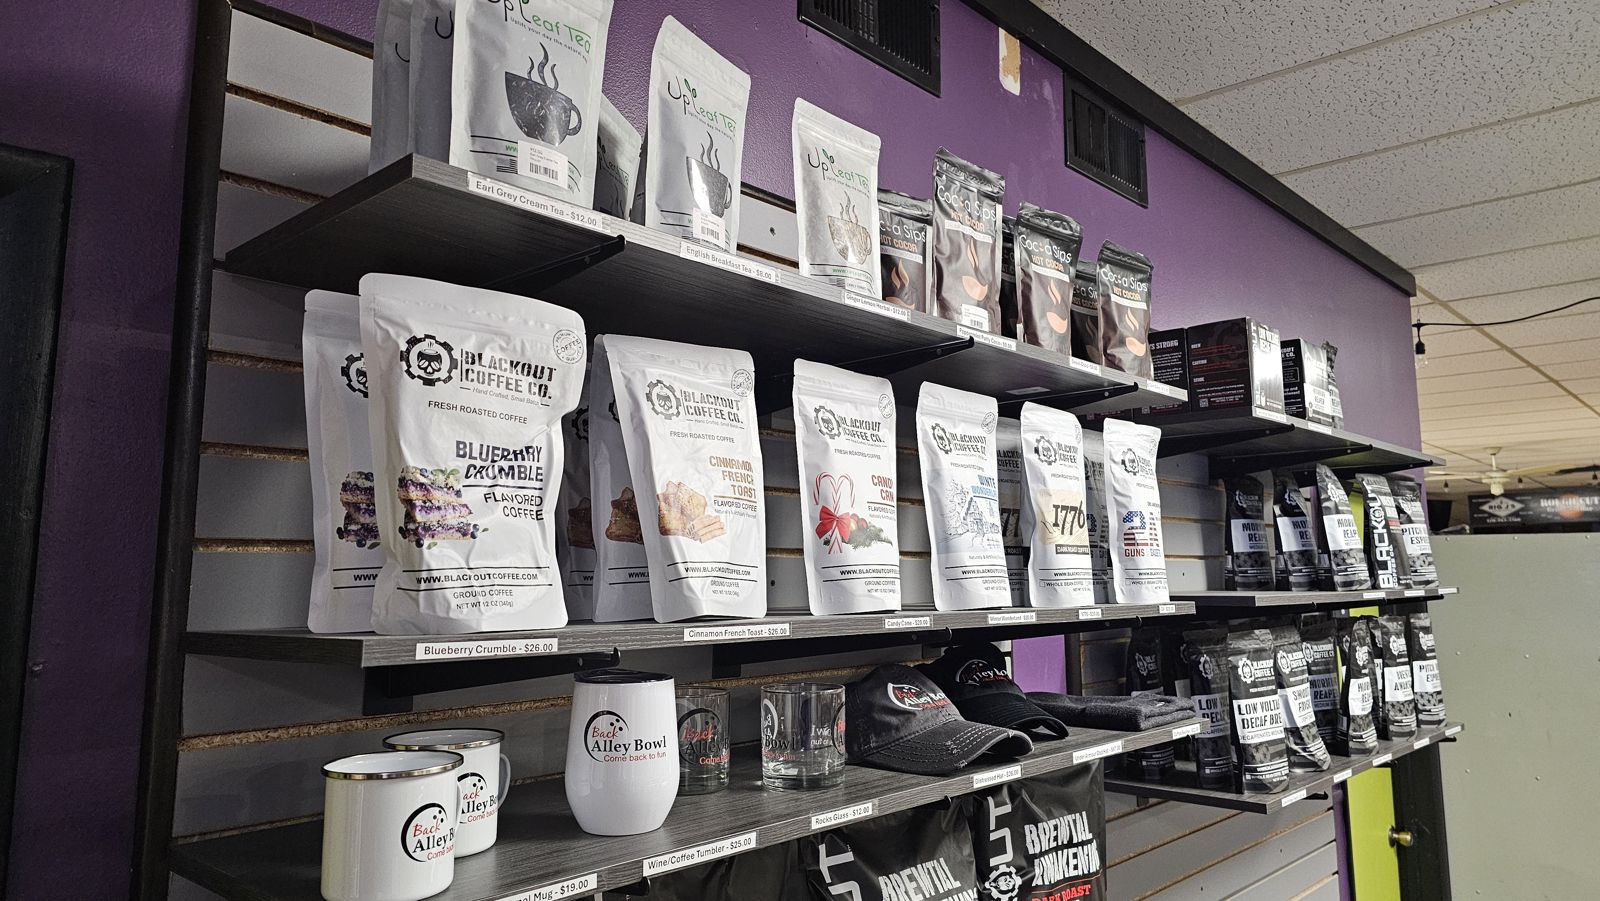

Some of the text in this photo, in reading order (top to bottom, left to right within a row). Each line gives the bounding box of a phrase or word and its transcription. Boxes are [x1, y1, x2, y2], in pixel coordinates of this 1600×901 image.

[564, 24, 591, 54] Tea
[476, 180, 597, 226] Earl Grey Cream Tea $12.00
[974, 200, 996, 221] Sips
[904, 224, 926, 242] Sips
[965, 218, 985, 232] COCOA
[893, 240, 918, 252] COCOA
[686, 246, 772, 280] English Breakfast Tea $8.00
[1031, 255, 1064, 272] HOT COCOA
[1053, 246, 1072, 264] Sips
[1130, 276, 1148, 292] Sips
[1122, 290, 1141, 301] COCOA
[1156, 340, 1179, 350] STRONG
[465, 350, 556, 382] BLACKOUT
[465, 368, 552, 400] COFFEE CO.
[683, 390, 740, 411] BLACKOUT
[428, 400, 528, 424] FRESH ROASTED COFFEE
[686, 405, 743, 424] COFFEE CO.
[838, 415, 881, 432] BLACKOUT
[842, 427, 885, 443] COFFEE CO.
[464, 464, 544, 482] CRUMBLE
[484, 492, 543, 507] FLAVORED
[731, 484, 756, 499] TOAST
[880, 488, 895, 503] CAN
[714, 500, 740, 509] FLAVORED
[502, 506, 544, 521] COFFEE
[1052, 500, 1085, 535] 1776
[1000, 508, 1020, 537] 77
[1124, 549, 1145, 557] GUNS
[416, 572, 538, 584] WWW.BLACKOUTCOFFEE.COM
[453, 589, 513, 599] GROUND COFFEE
[689, 630, 723, 638] Cinnamon
[424, 642, 553, 656] Blueberry Crumble $26.00
[904, 692, 946, 707] Alley Bo
[1198, 698, 1218, 710] LOW
[1237, 703, 1257, 715] LOW
[1260, 699, 1280, 713] VOLT
[1241, 713, 1282, 729] DECAF BRE
[592, 725, 618, 739] Back
[591, 736, 666, 756] Alley Bowl
[630, 753, 647, 761] back
[463, 782, 481, 800] ack
[468, 814, 485, 823] Come
[816, 806, 870, 825] Rocks Glass $12.00
[413, 817, 441, 837] Back
[1024, 811, 1093, 855] BREWTAL
[412, 832, 448, 853] Alley
[427, 849, 445, 860] Come
[648, 837, 752, 870] Wine/Coffee Tumbler $25.00
[1032, 839, 1100, 887] AWAKENIN
[878, 857, 961, 901] BREWTAL
[534, 880, 588, 901] Mug $19.00
[1062, 884, 1091, 900] ROAST
